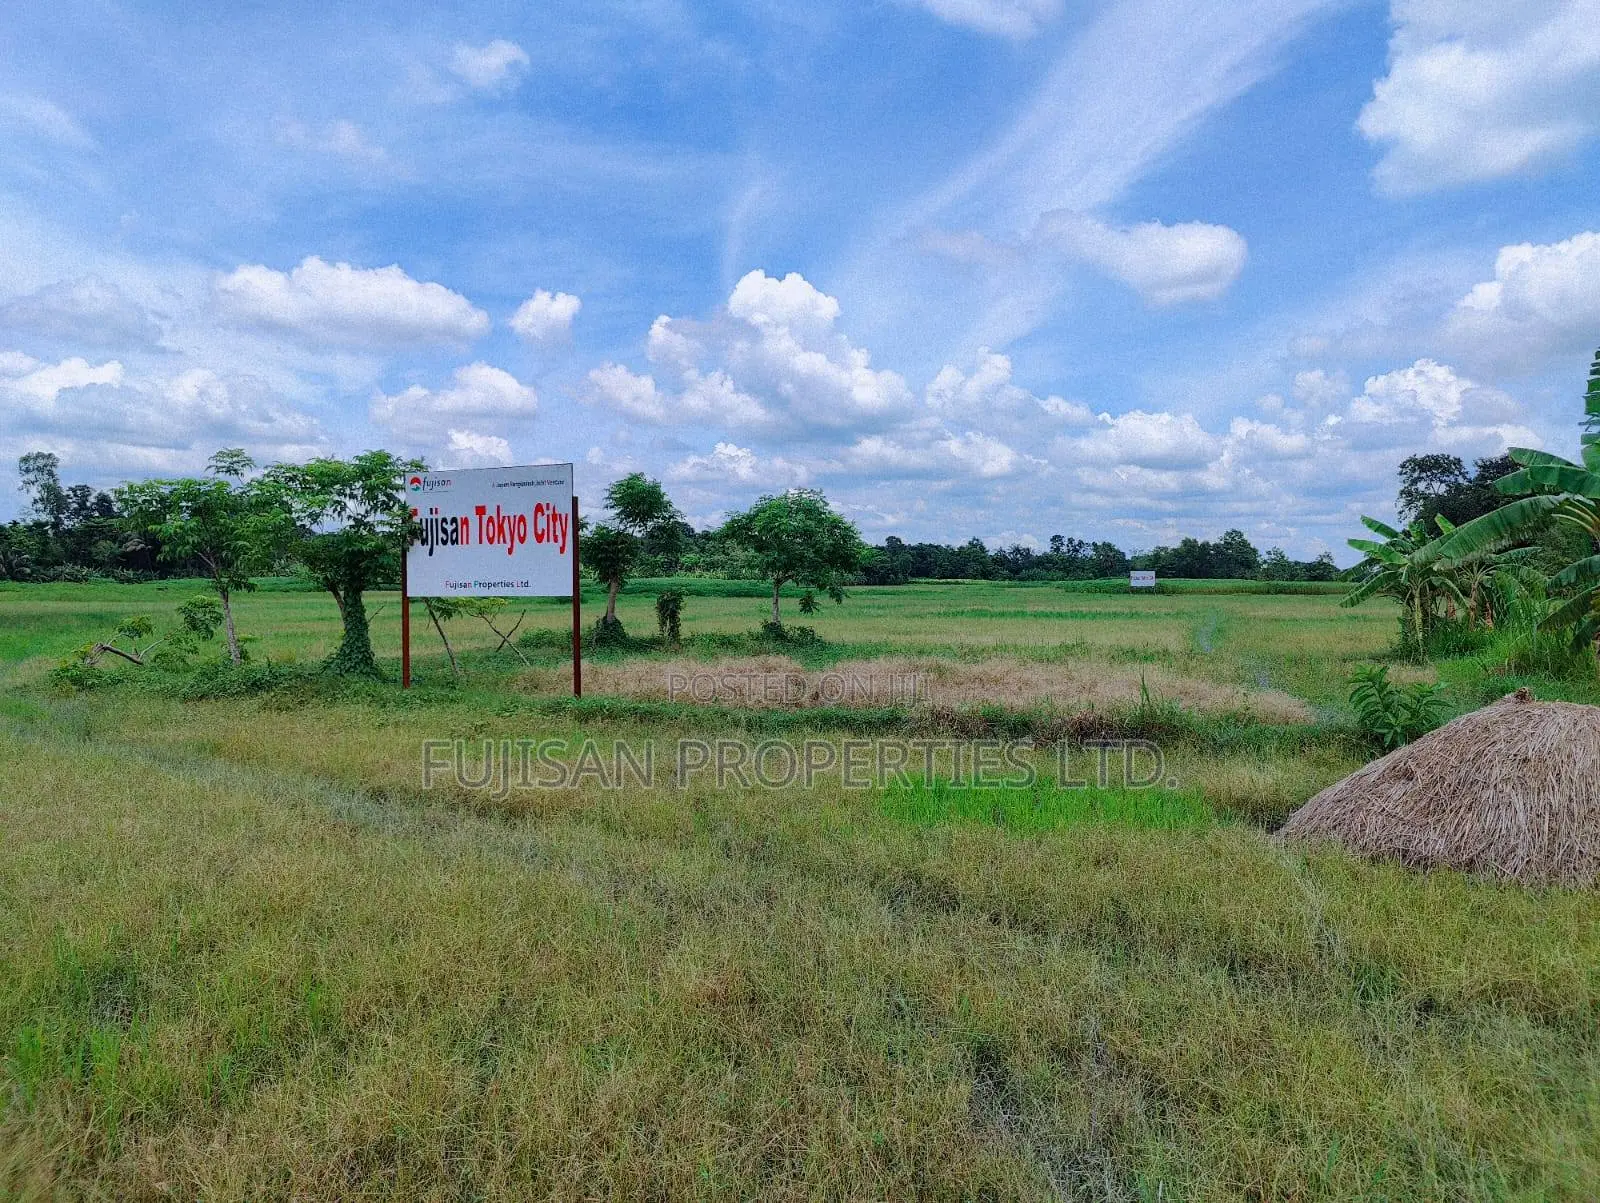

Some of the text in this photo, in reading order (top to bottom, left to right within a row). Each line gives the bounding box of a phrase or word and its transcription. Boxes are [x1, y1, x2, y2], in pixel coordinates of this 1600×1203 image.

[422, 476, 452, 491] fujisan
[475, 504, 528, 556] Tokyo
[533, 502, 569, 555] City
[445, 580, 532, 590] Fujisan Properties Ltd.
